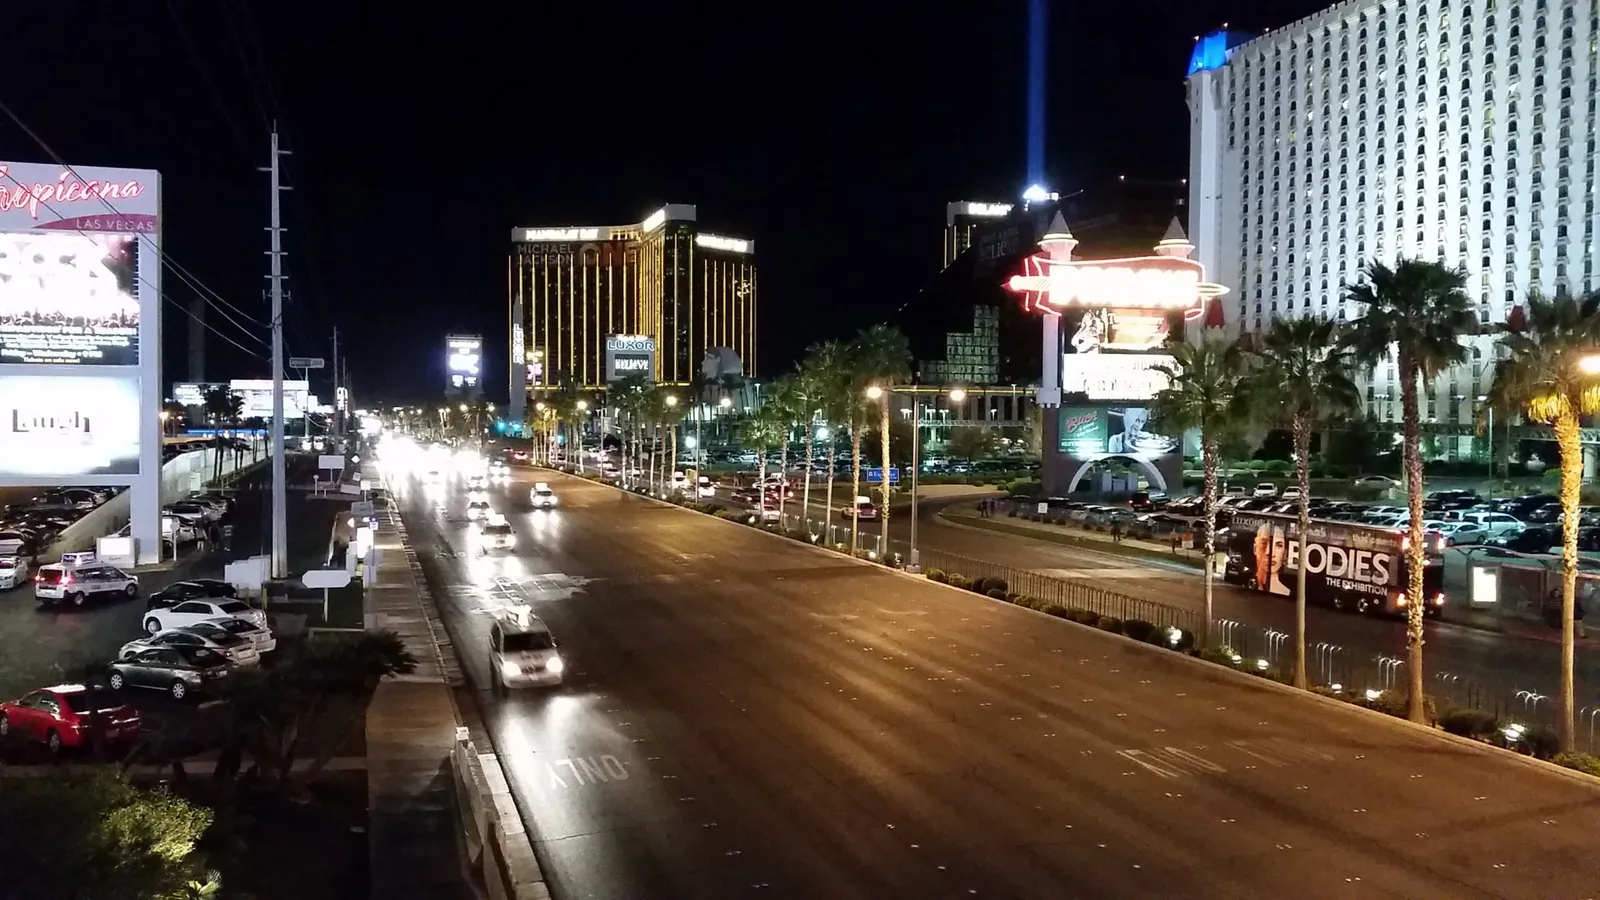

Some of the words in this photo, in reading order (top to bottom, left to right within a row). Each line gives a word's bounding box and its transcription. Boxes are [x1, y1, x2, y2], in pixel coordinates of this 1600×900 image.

[0, 166, 145, 220] ropicana
[76, 218, 102, 229] LAS
[106, 220, 154, 231] VEGAS
[517, 243, 575, 254] MICHAEL
[579, 243, 638, 266] ONE
[516, 254, 573, 265] JACKSON
[512, 323, 525, 364] LUXOR
[607, 340, 655, 351] LUXOR
[1288, 540, 1390, 586] BODIES
[1326, 577, 1342, 588] THE
[1342, 580, 1388, 597] EXHIBITION
[545, 754, 629, 790] ONLY
